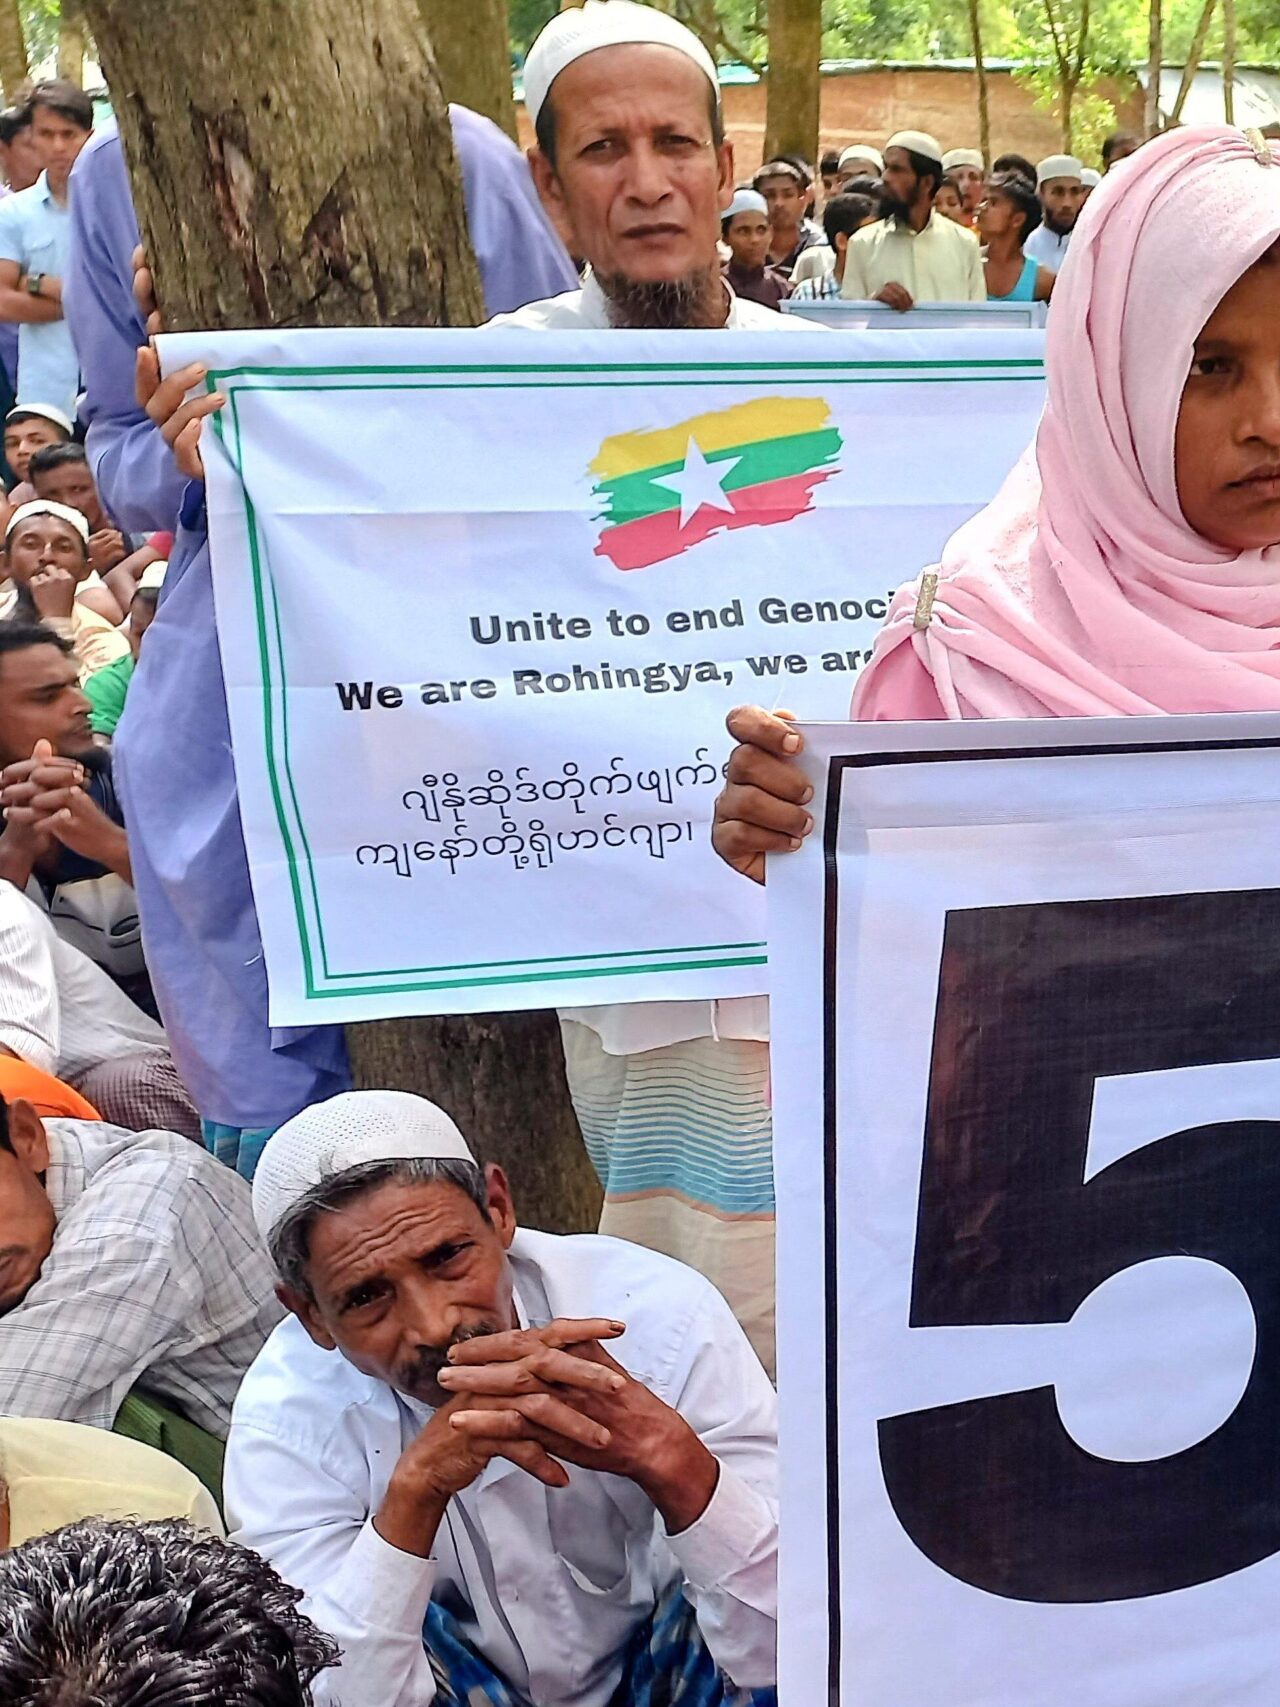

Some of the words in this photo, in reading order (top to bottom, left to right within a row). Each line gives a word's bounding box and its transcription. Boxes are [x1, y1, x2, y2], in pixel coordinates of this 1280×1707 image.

[469, 612, 592, 645] Unite
[606, 609, 650, 637] to
[666, 599, 744, 633] end
[335, 681, 404, 711] We
[420, 677, 497, 706] are
[513, 661, 733, 695] Rohingya,
[745, 652, 808, 677] we
[403, 747, 730, 822] ဂျီနိုဆိုဒ်တိုက်ဖျက်
